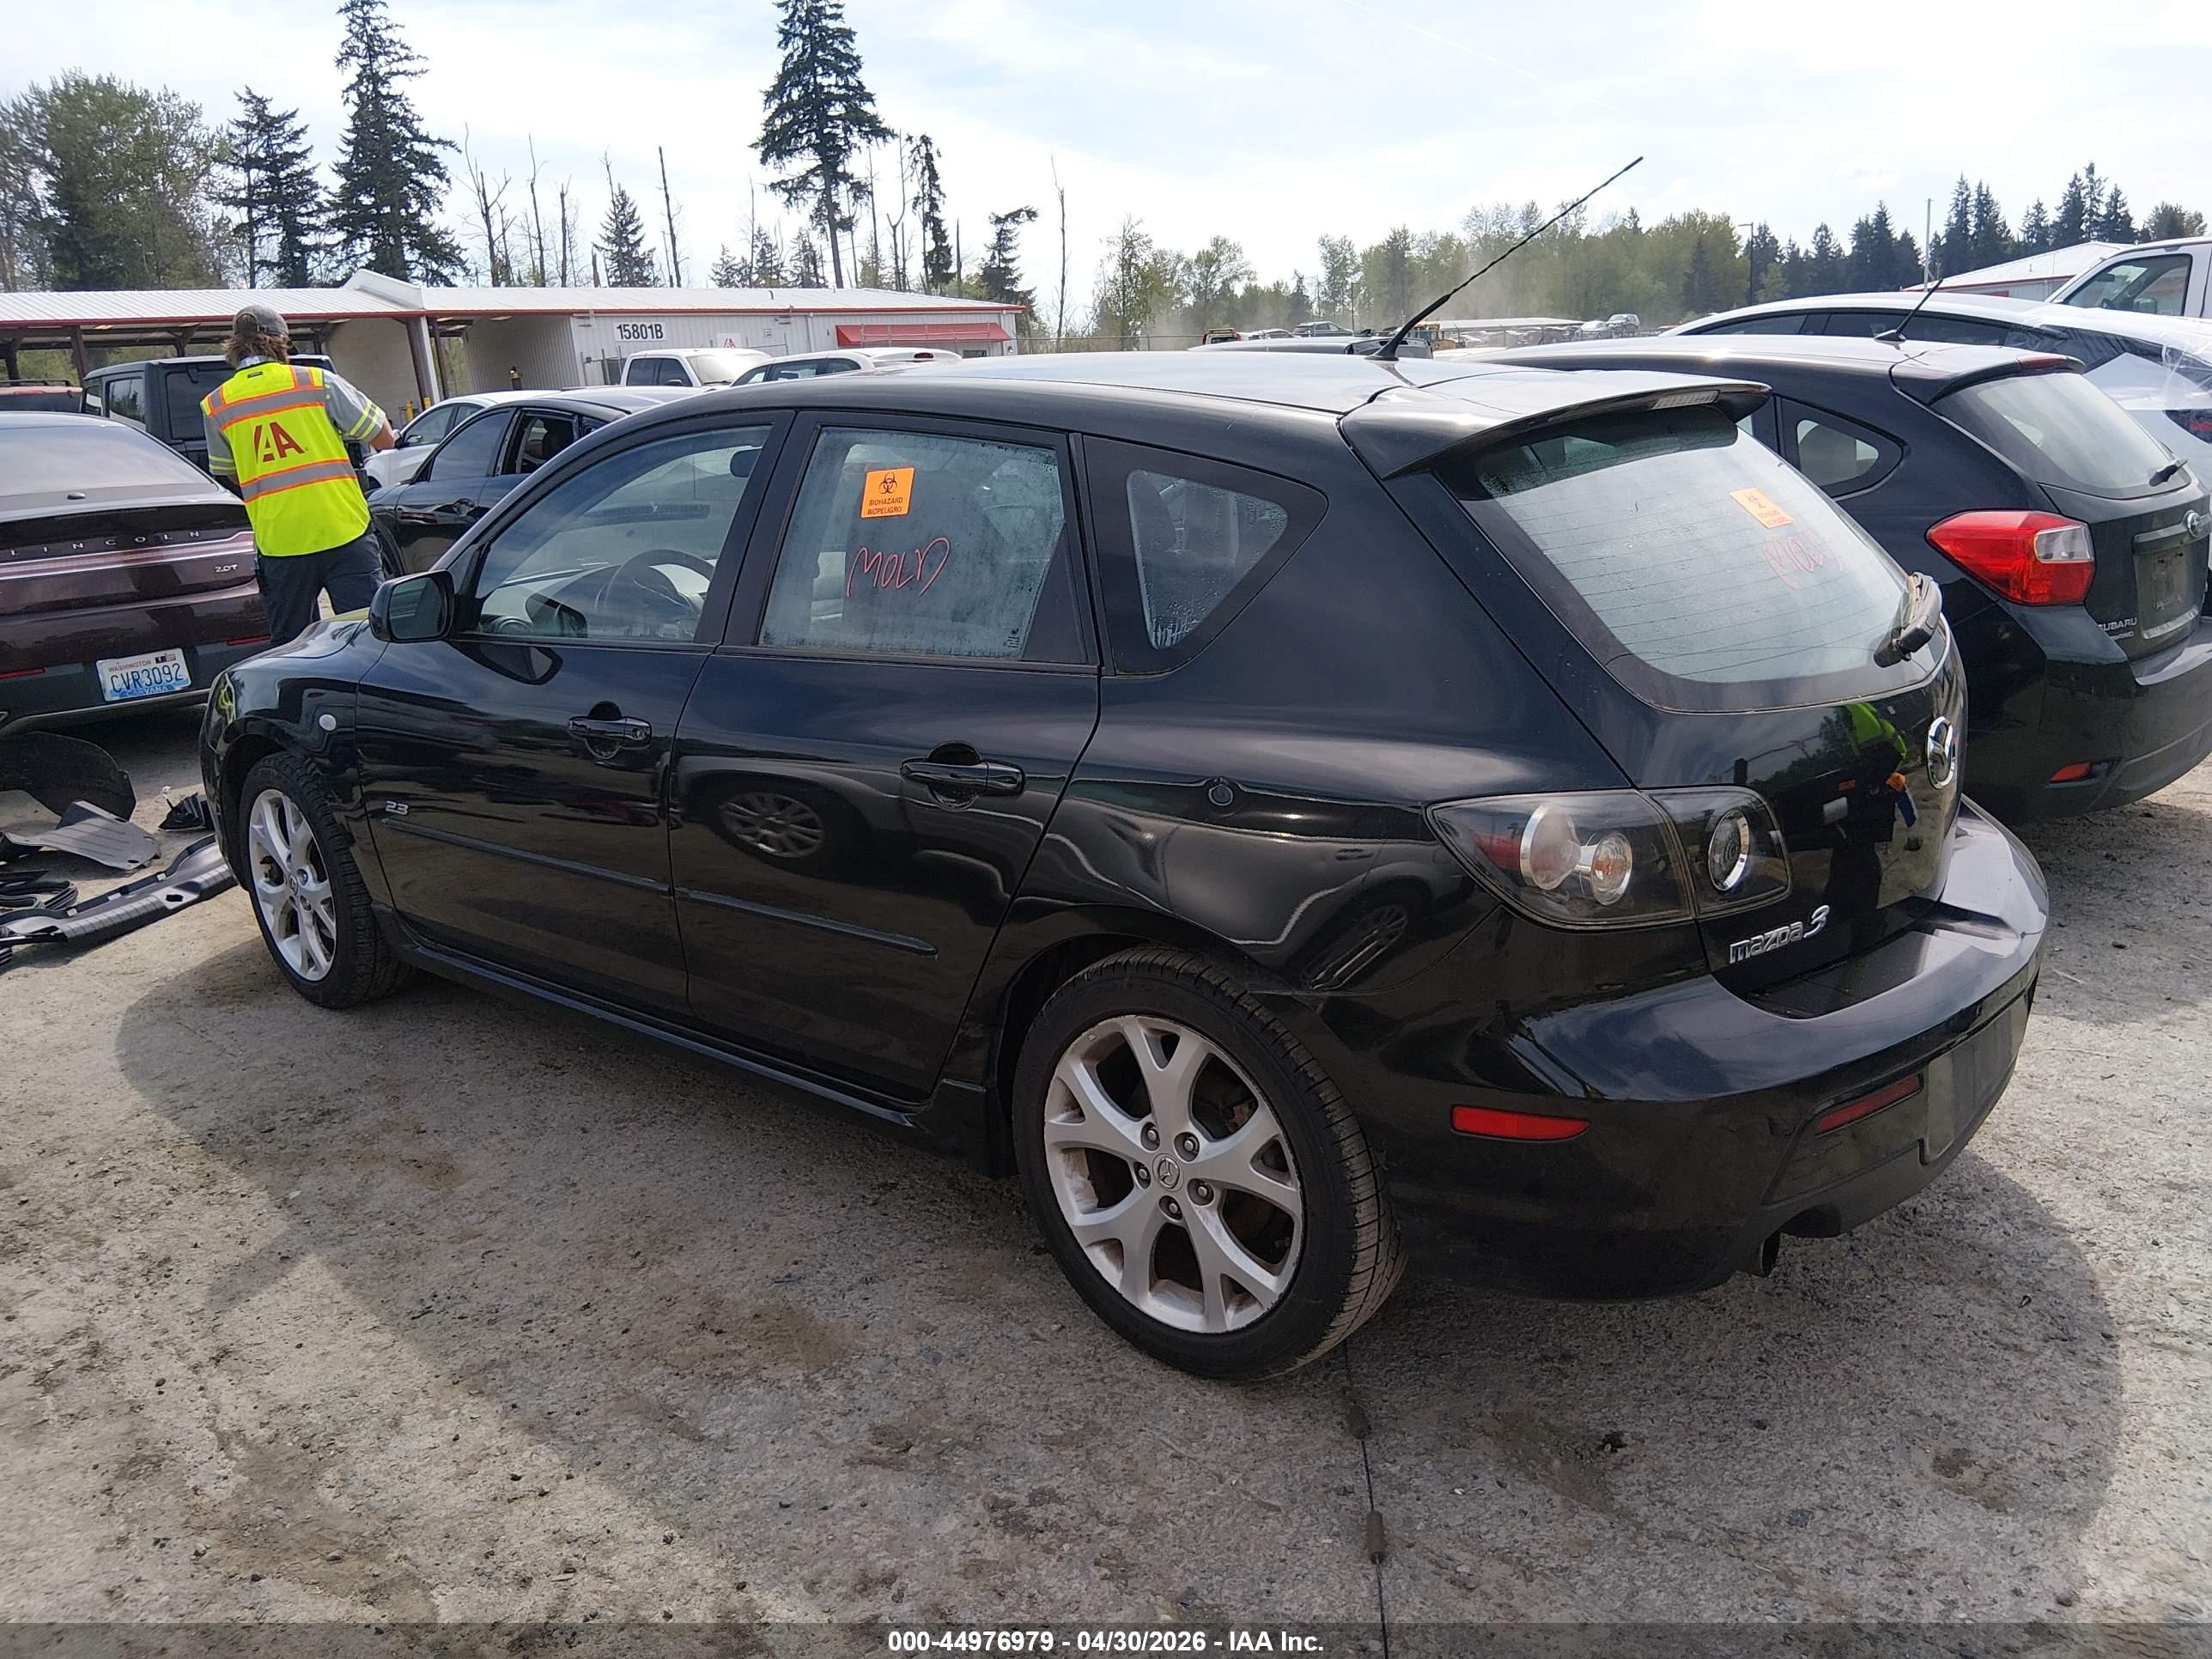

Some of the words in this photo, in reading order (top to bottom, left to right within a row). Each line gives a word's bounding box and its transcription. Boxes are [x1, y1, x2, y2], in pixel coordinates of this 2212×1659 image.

[617, 323, 664, 340] 15801B
[867, 506, 902, 515] BIOPELIGRO
[868, 497, 903, 507] BIOHAZARD
[10, 530, 200, 556] LINCOLN
[847, 537, 951, 598] MOLD
[108, 659, 152, 673] WASHINGTON
[110, 662, 184, 693] CVR3092
[1803, 904, 1831, 938] 3
